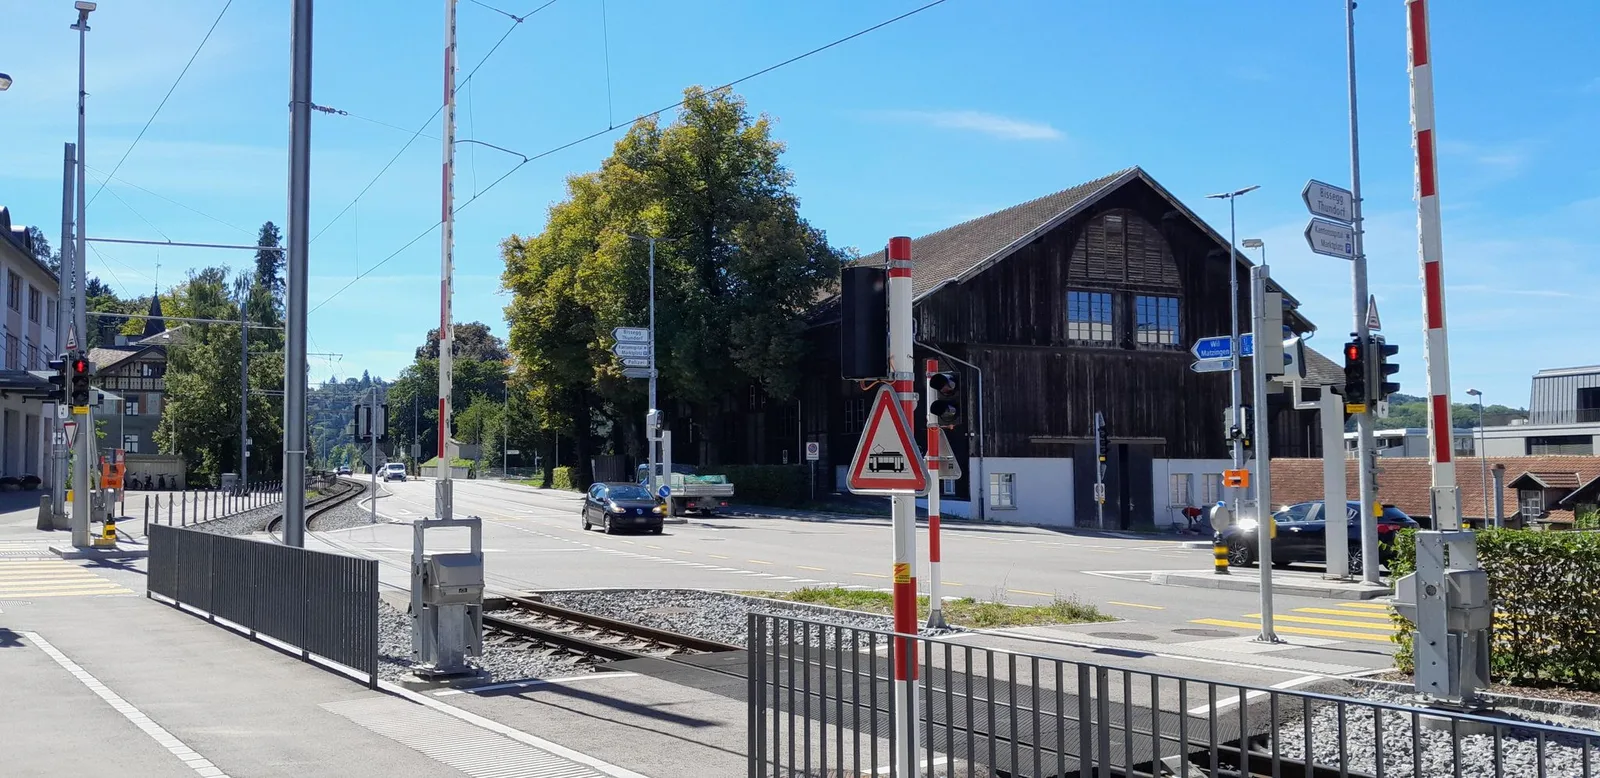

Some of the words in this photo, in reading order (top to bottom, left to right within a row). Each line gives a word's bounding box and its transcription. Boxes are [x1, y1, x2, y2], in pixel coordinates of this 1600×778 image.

[1320, 187, 1344, 205] Bissegg
[1317, 200, 1346, 217] Thundorf
[1210, 339, 1220, 348] Wil
[1201, 349, 1230, 357] Matzingen
